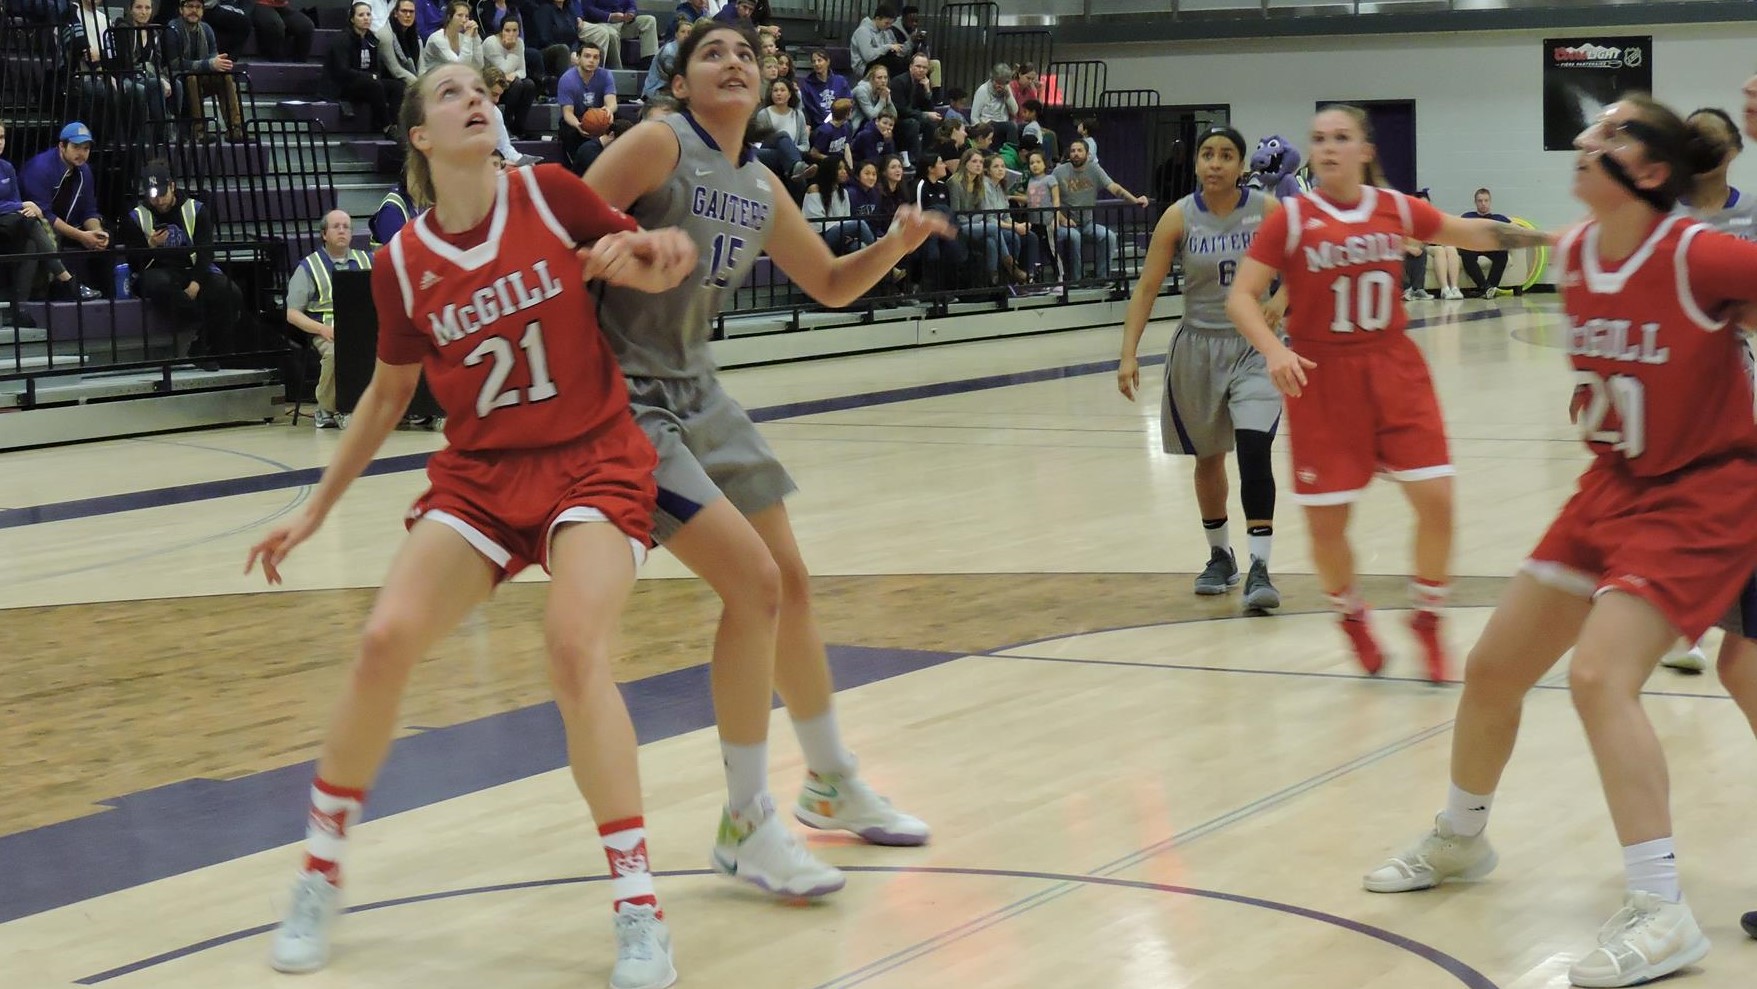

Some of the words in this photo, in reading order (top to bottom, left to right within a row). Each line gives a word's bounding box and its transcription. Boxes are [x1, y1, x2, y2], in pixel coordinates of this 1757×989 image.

[1588, 50, 1619, 60] LIGHT
[427, 259, 564, 347] McGILL
[1330, 270, 1394, 333] 10
[463, 320, 558, 419] 21
